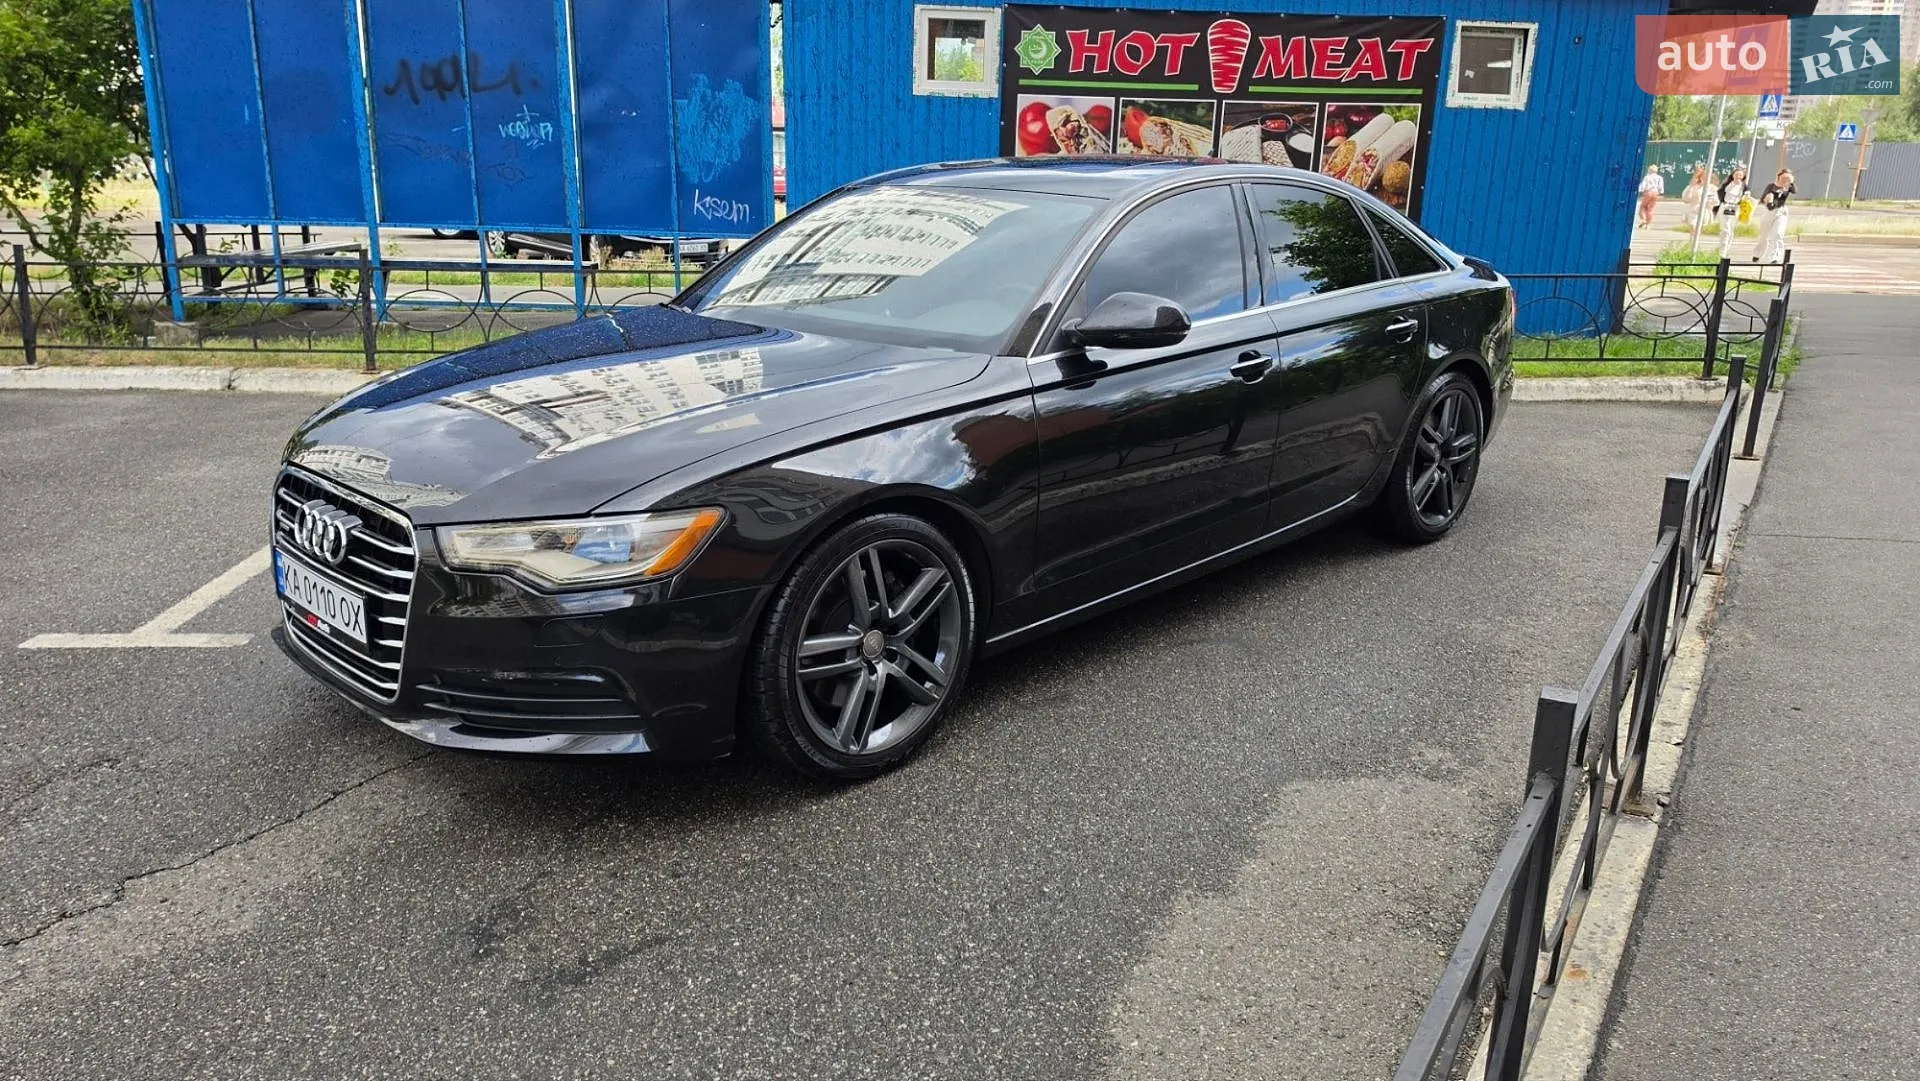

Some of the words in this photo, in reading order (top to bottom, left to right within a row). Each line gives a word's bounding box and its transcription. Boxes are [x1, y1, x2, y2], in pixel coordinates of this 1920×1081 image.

[1065, 28, 1200, 76] HOT
[1252, 35, 1435, 83] MEAT
[282, 564, 300, 597] KA
[303, 574, 336, 620] 0110
[340, 596, 363, 636] OX
